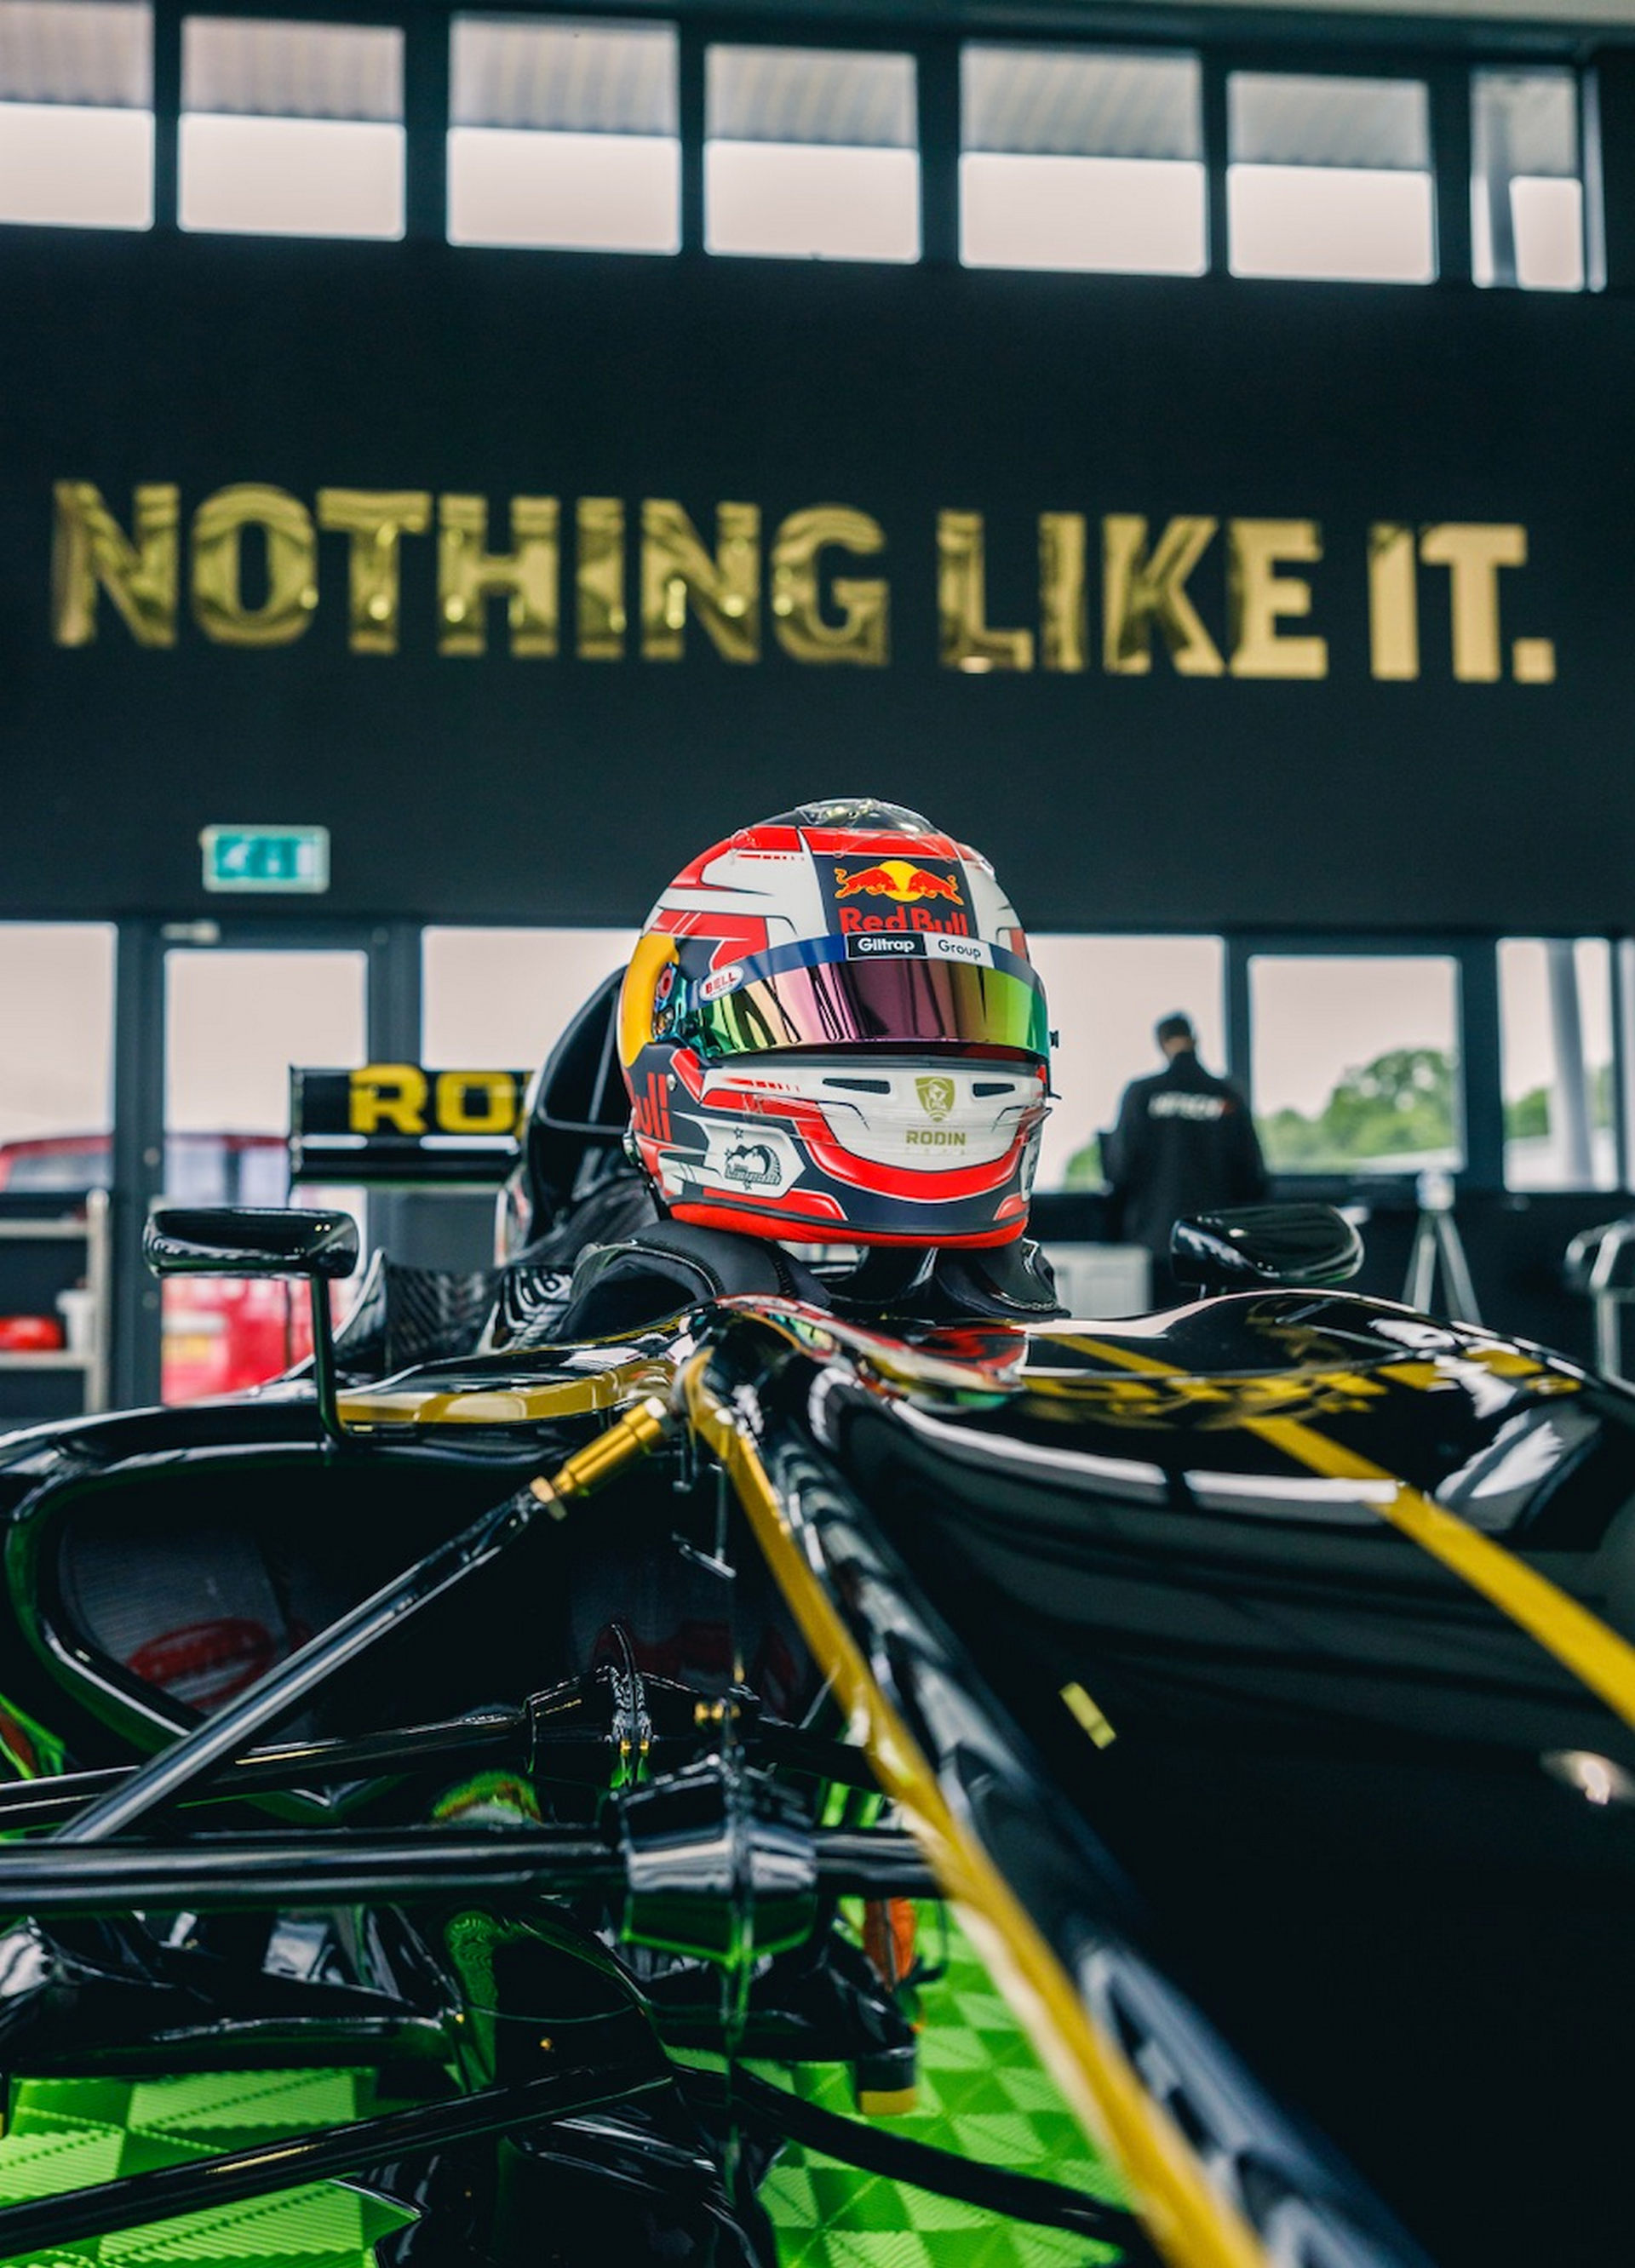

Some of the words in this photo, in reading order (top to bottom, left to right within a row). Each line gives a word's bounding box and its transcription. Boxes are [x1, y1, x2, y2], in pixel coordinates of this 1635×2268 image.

[52, 479, 889, 667] NOTHING
[938, 509, 1328, 679] LIKE
[1368, 522, 1556, 682] IT.
[838, 905, 909, 935] Red
[909, 907, 968, 936] Bull
[857, 937, 915, 953] Giltrap
[938, 939, 982, 960] Group
[705, 971, 737, 995] BELL
[349, 1063, 535, 1140] RO
[905, 1129, 967, 1147] RODIN
